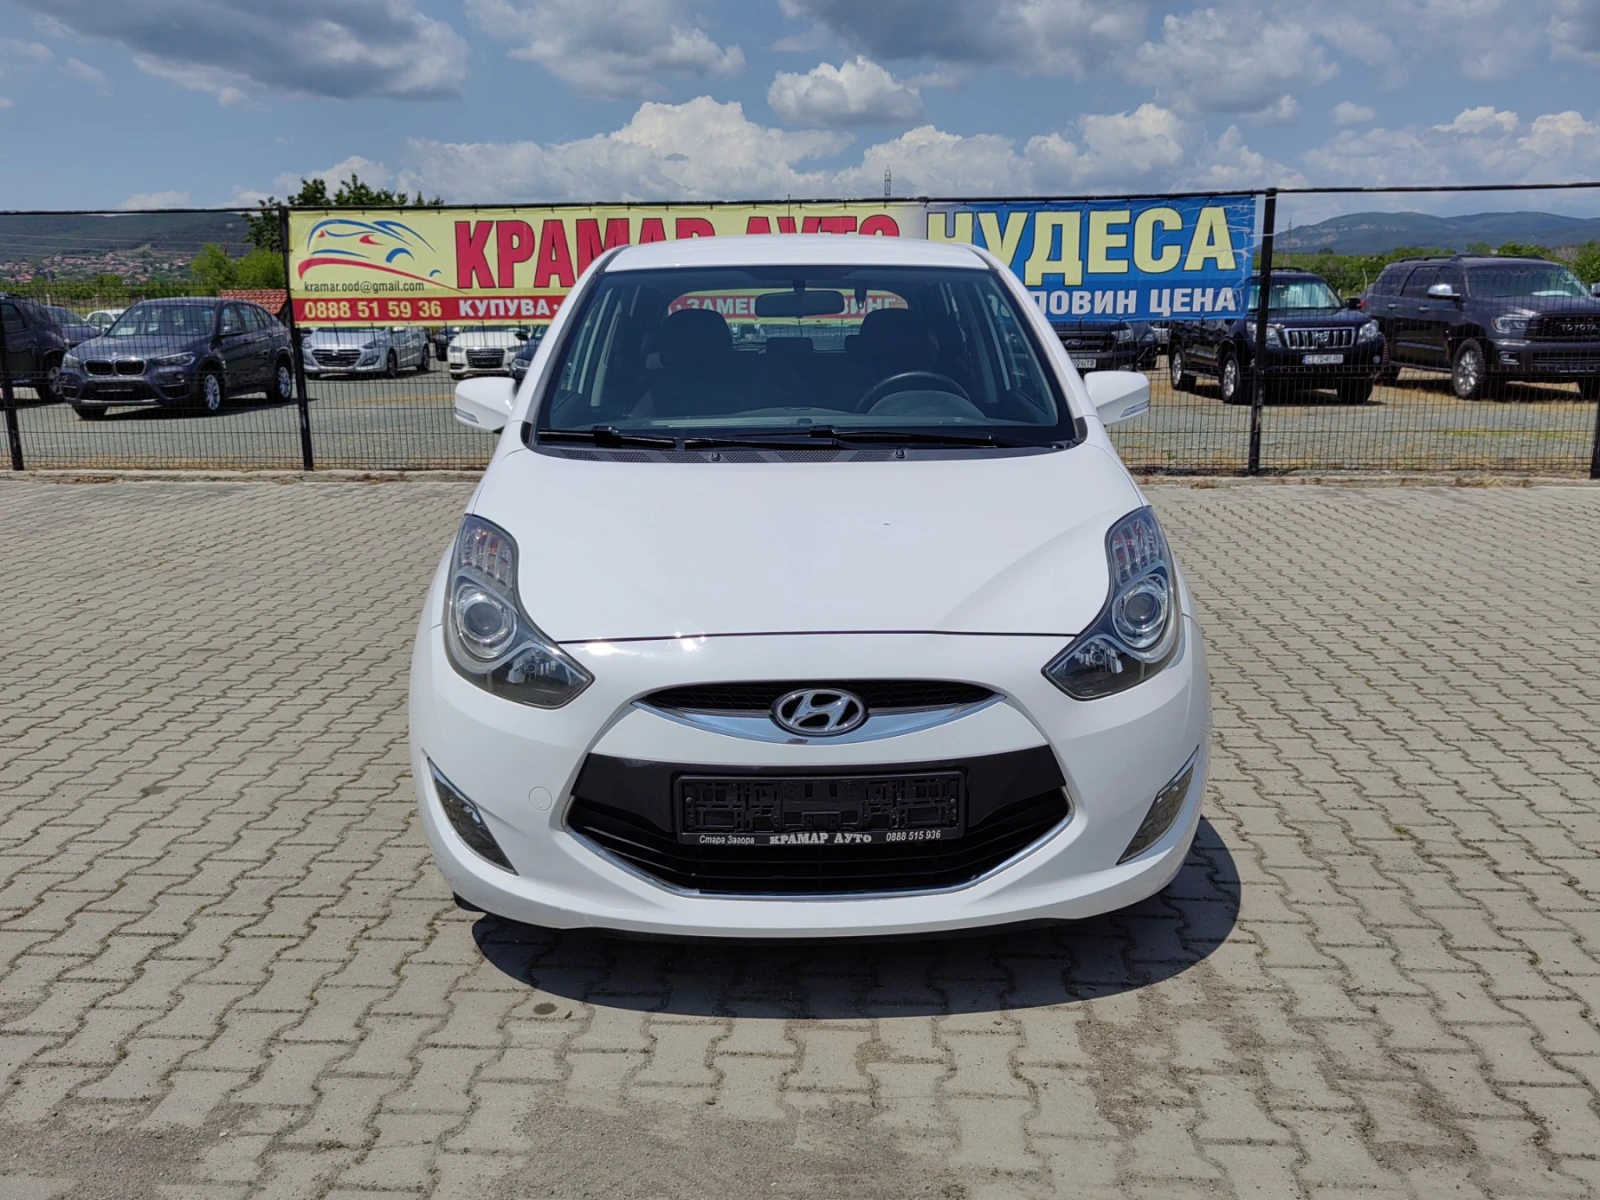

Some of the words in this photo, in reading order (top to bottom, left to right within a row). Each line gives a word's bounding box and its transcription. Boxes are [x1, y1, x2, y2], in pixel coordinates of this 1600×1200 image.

[304, 281, 425, 294] kramar.ood@gmail.com
[304, 301, 351, 318] 0888
[357, 301, 379, 318] 51
[387, 301, 411, 318] 59
[418, 301, 442, 317] 36
[460, 299, 551, 316] КУПУВА
[1149, 287, 1236, 317] ЦЕНА
[769, 833, 829, 845] КРАМАР
[886, 832, 906, 842] 0888
[908, 831, 924, 841] 515
[925, 830, 941, 840] 936
